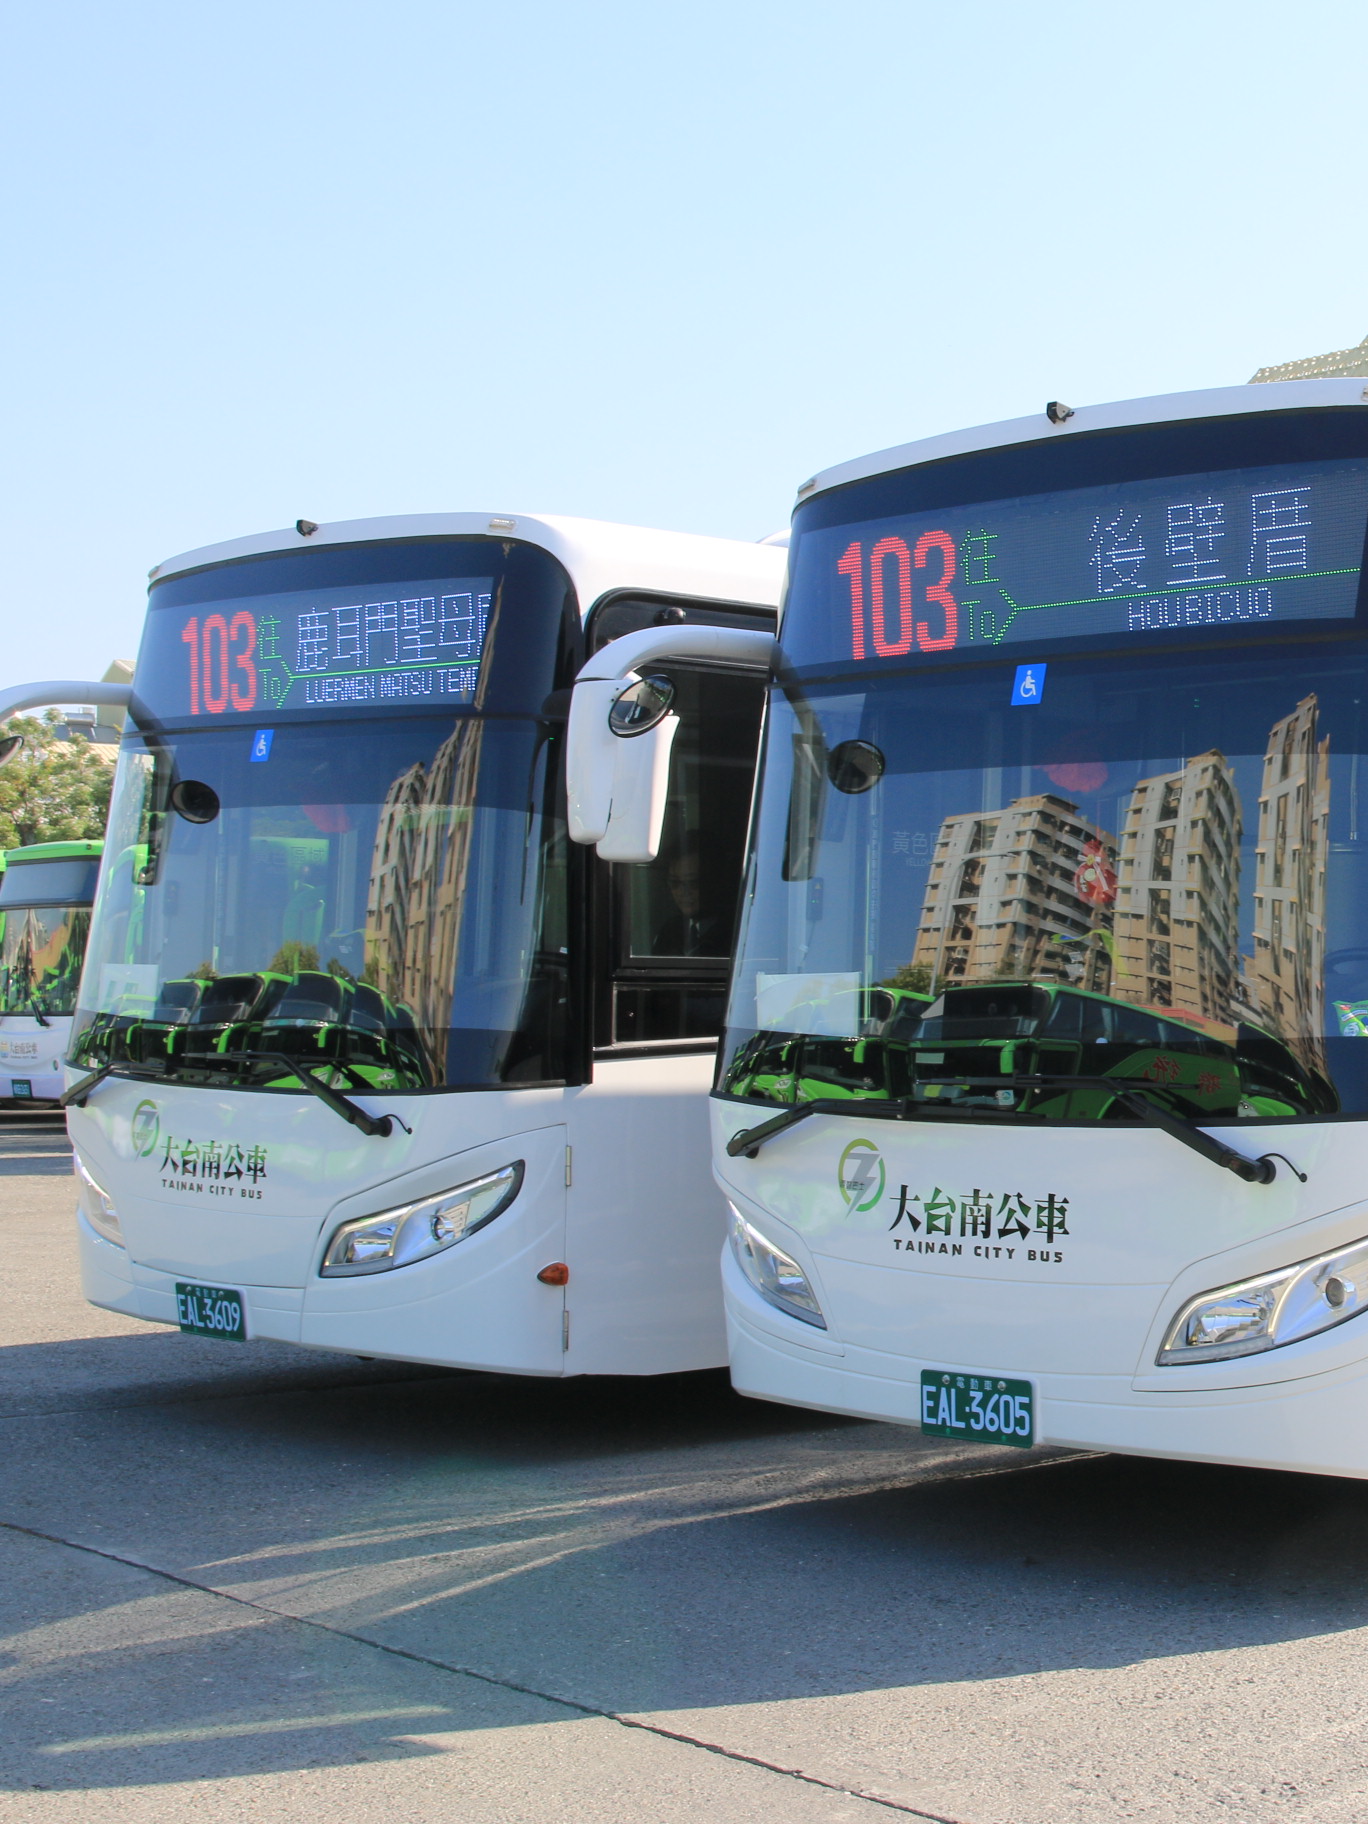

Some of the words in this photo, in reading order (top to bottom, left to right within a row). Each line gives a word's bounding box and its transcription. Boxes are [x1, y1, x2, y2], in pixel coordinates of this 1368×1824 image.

[959, 528, 1000, 585] 往
[1089, 486, 1312, 593] 後壁厝
[837, 529, 958, 660] 103
[1127, 588, 1273, 632] HOUBICUO
[256, 614, 283, 660] 往
[960, 600, 996, 640] To
[181, 611, 258, 714] 103
[258, 668, 282, 701] To
[305, 675, 375, 703] LUERMEN
[380, 671, 434, 698] MATSU
[158, 1135, 268, 1185] 大台南公車
[161, 1178, 204, 1193] TAINAN
[209, 1185, 235, 1197] CITY
[241, 1188, 263, 1200] BUS
[889, 1184, 1070, 1244] 大台南公車
[893, 1239, 963, 1257] TAINAN
[974, 1245, 1016, 1259] CITY
[1028, 1250, 1063, 1263] BUS
[922, 1384, 1030, 1436] EAL-3605
